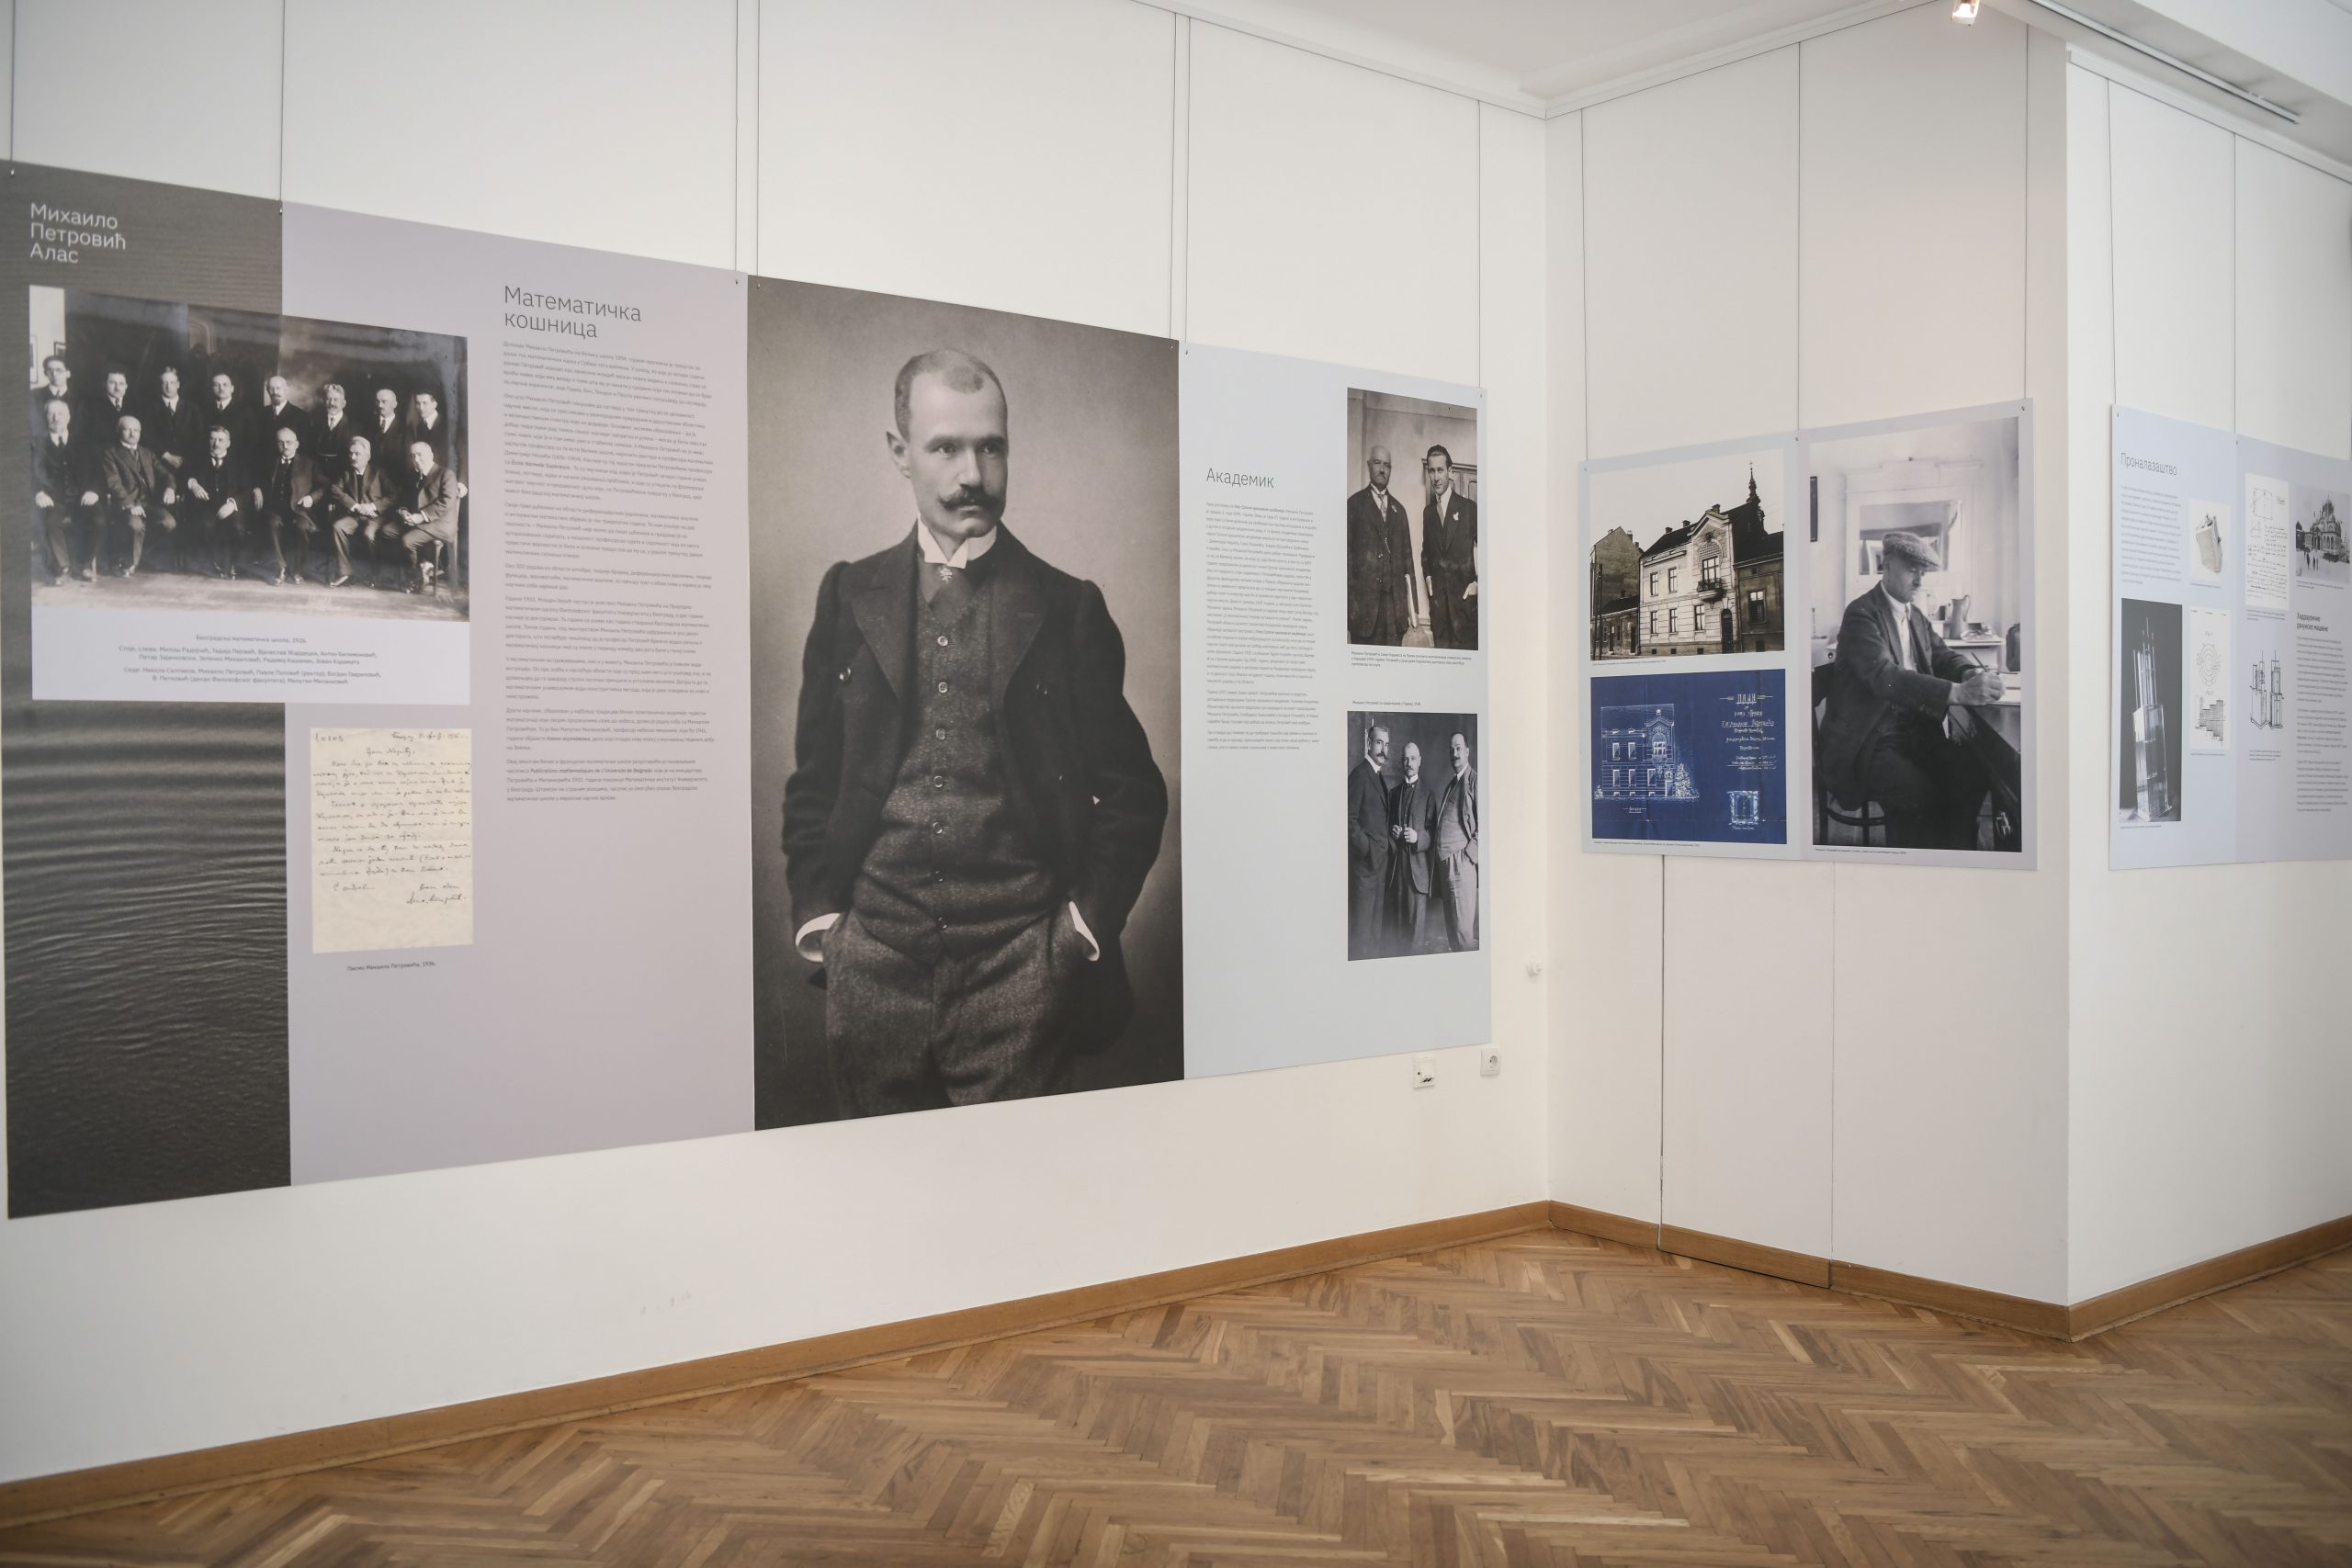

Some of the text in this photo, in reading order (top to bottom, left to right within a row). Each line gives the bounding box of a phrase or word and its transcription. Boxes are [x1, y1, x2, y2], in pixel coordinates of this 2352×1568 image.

[30, 202, 118, 230] Михаило
[30, 223, 125, 250] Петровић
[29, 243, 78, 264] Алас
[504, 285, 641, 321] Математичка
[505, 313, 597, 339] кошница
[2120, 453, 2177, 476] Проналазаштво
[1205, 468, 1275, 489] Академик
